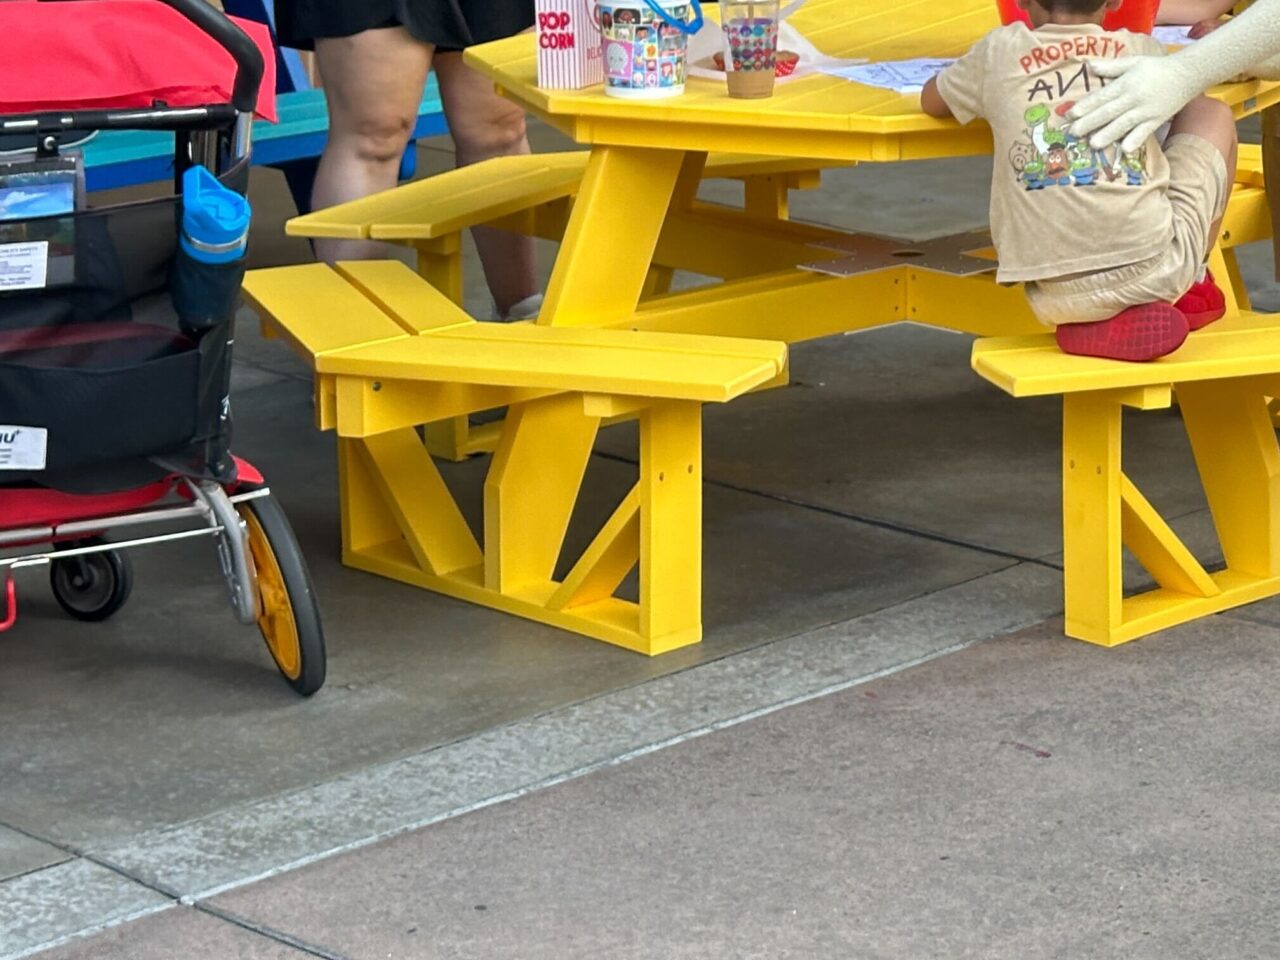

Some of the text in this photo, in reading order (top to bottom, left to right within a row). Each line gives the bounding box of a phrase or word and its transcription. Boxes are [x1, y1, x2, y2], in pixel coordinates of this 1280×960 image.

[538, 12, 571, 31] POP
[539, 32, 574, 50] CORN
[1019, 35, 1125, 74] PROPERTY
